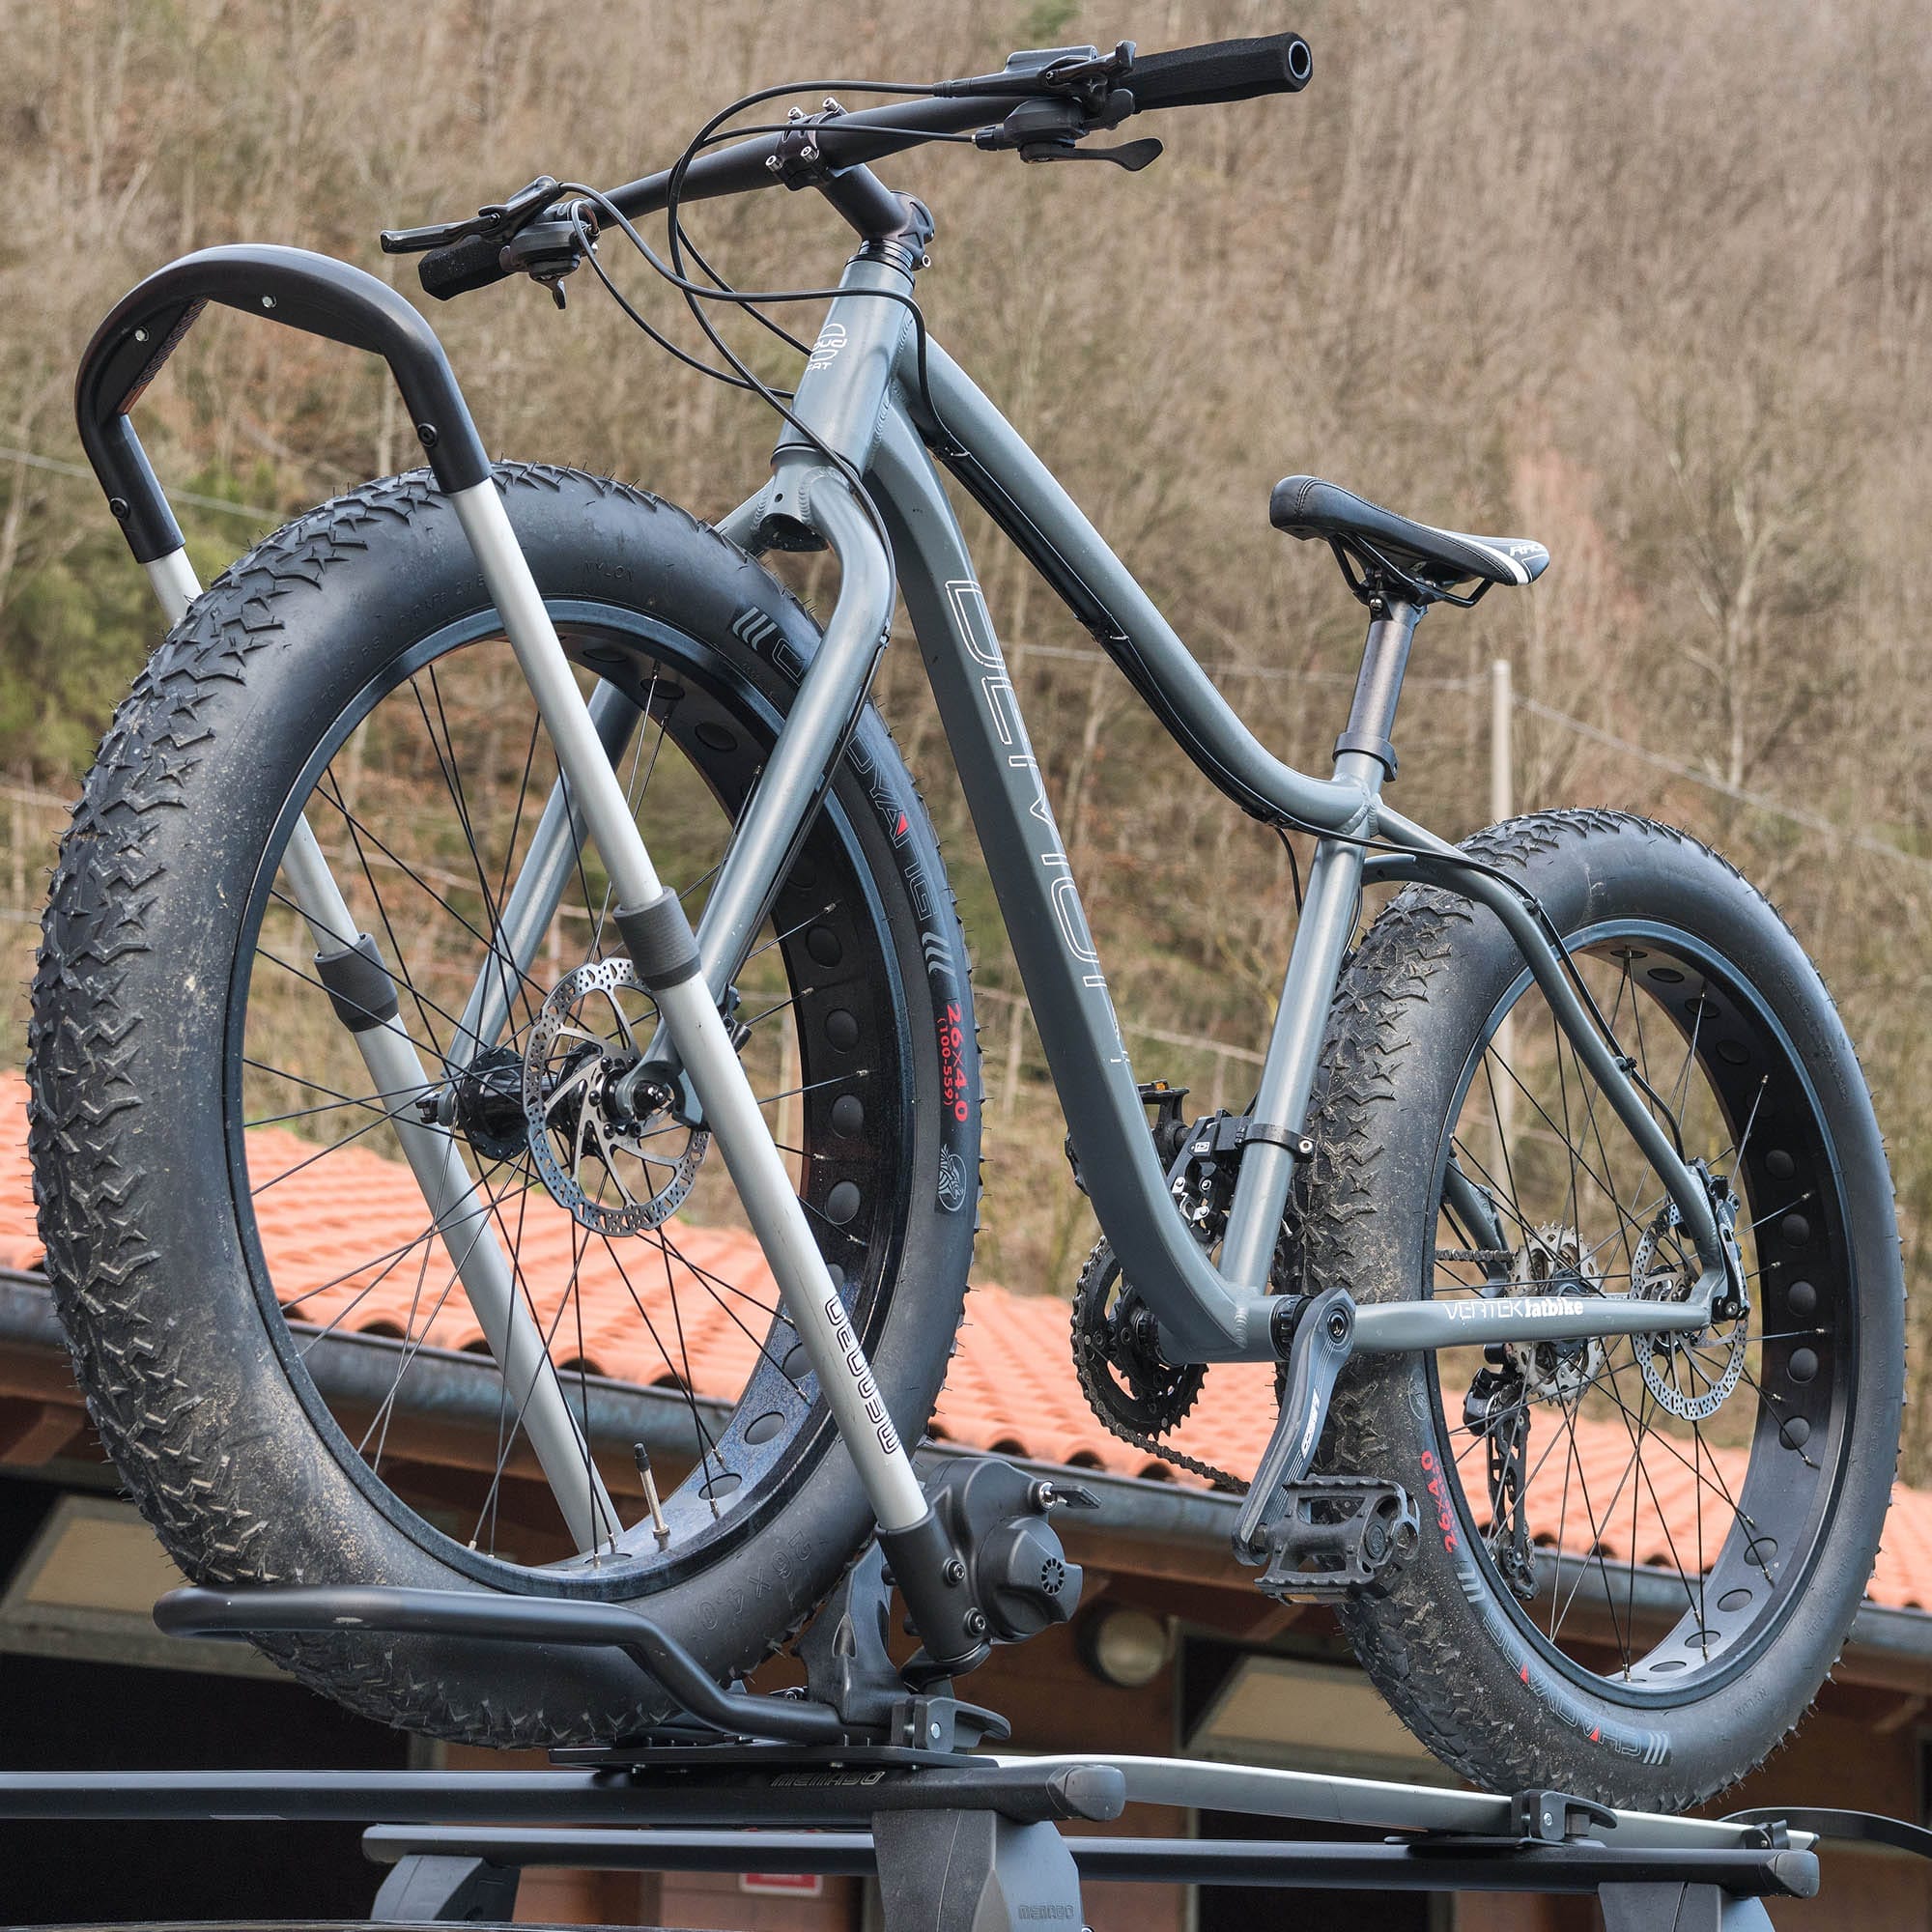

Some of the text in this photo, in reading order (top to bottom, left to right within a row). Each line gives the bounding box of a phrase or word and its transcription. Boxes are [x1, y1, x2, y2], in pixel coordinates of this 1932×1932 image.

[773, 638, 936, 923] COYANG
[936, 1017, 953, 1107] (100-559)
[1443, 1300, 1523, 1320] VERTEK
